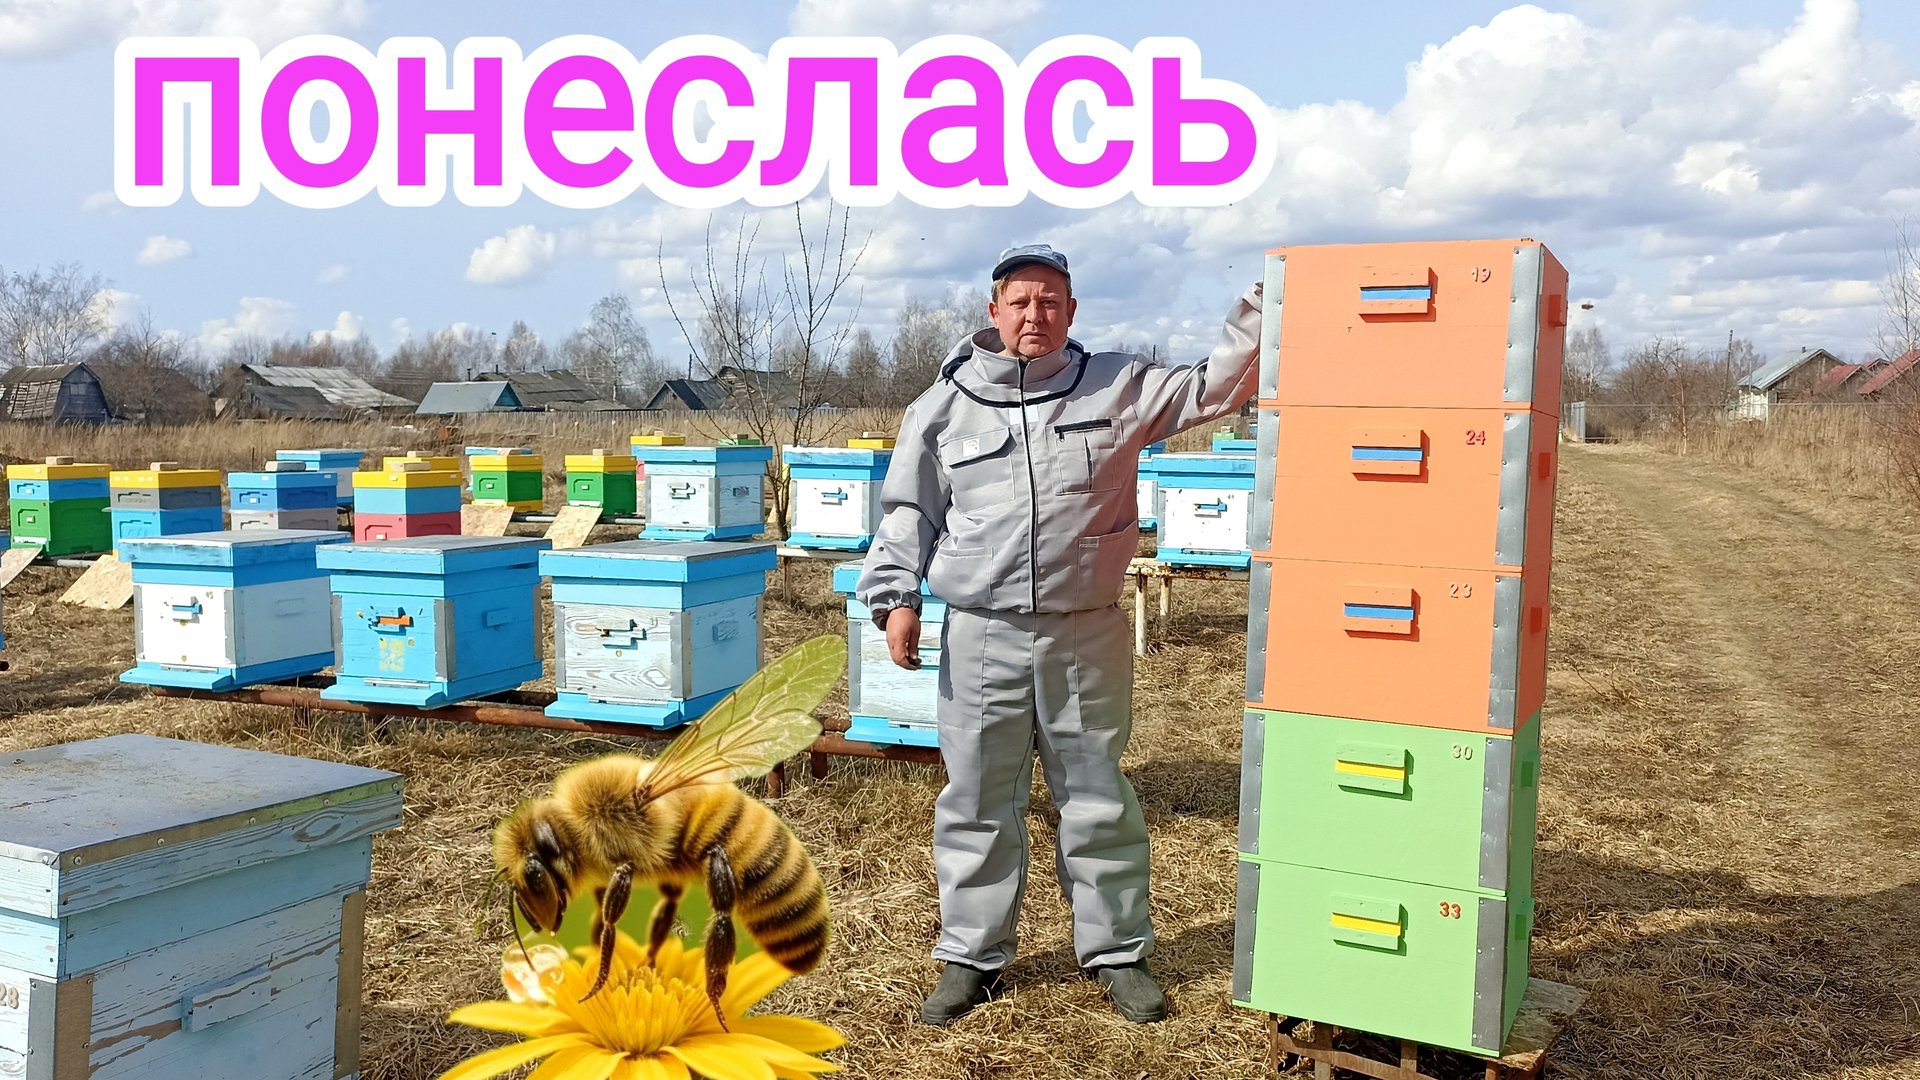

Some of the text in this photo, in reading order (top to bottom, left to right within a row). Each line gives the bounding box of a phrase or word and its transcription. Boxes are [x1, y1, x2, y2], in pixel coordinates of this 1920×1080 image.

[1471, 266, 1492, 284] 19
[1465, 429, 1487, 446] 24
[1449, 582, 1474, 599] 23
[1452, 744, 1474, 761] 30
[1438, 901, 1462, 920] 33
[0, 982, 19, 1010] 28
